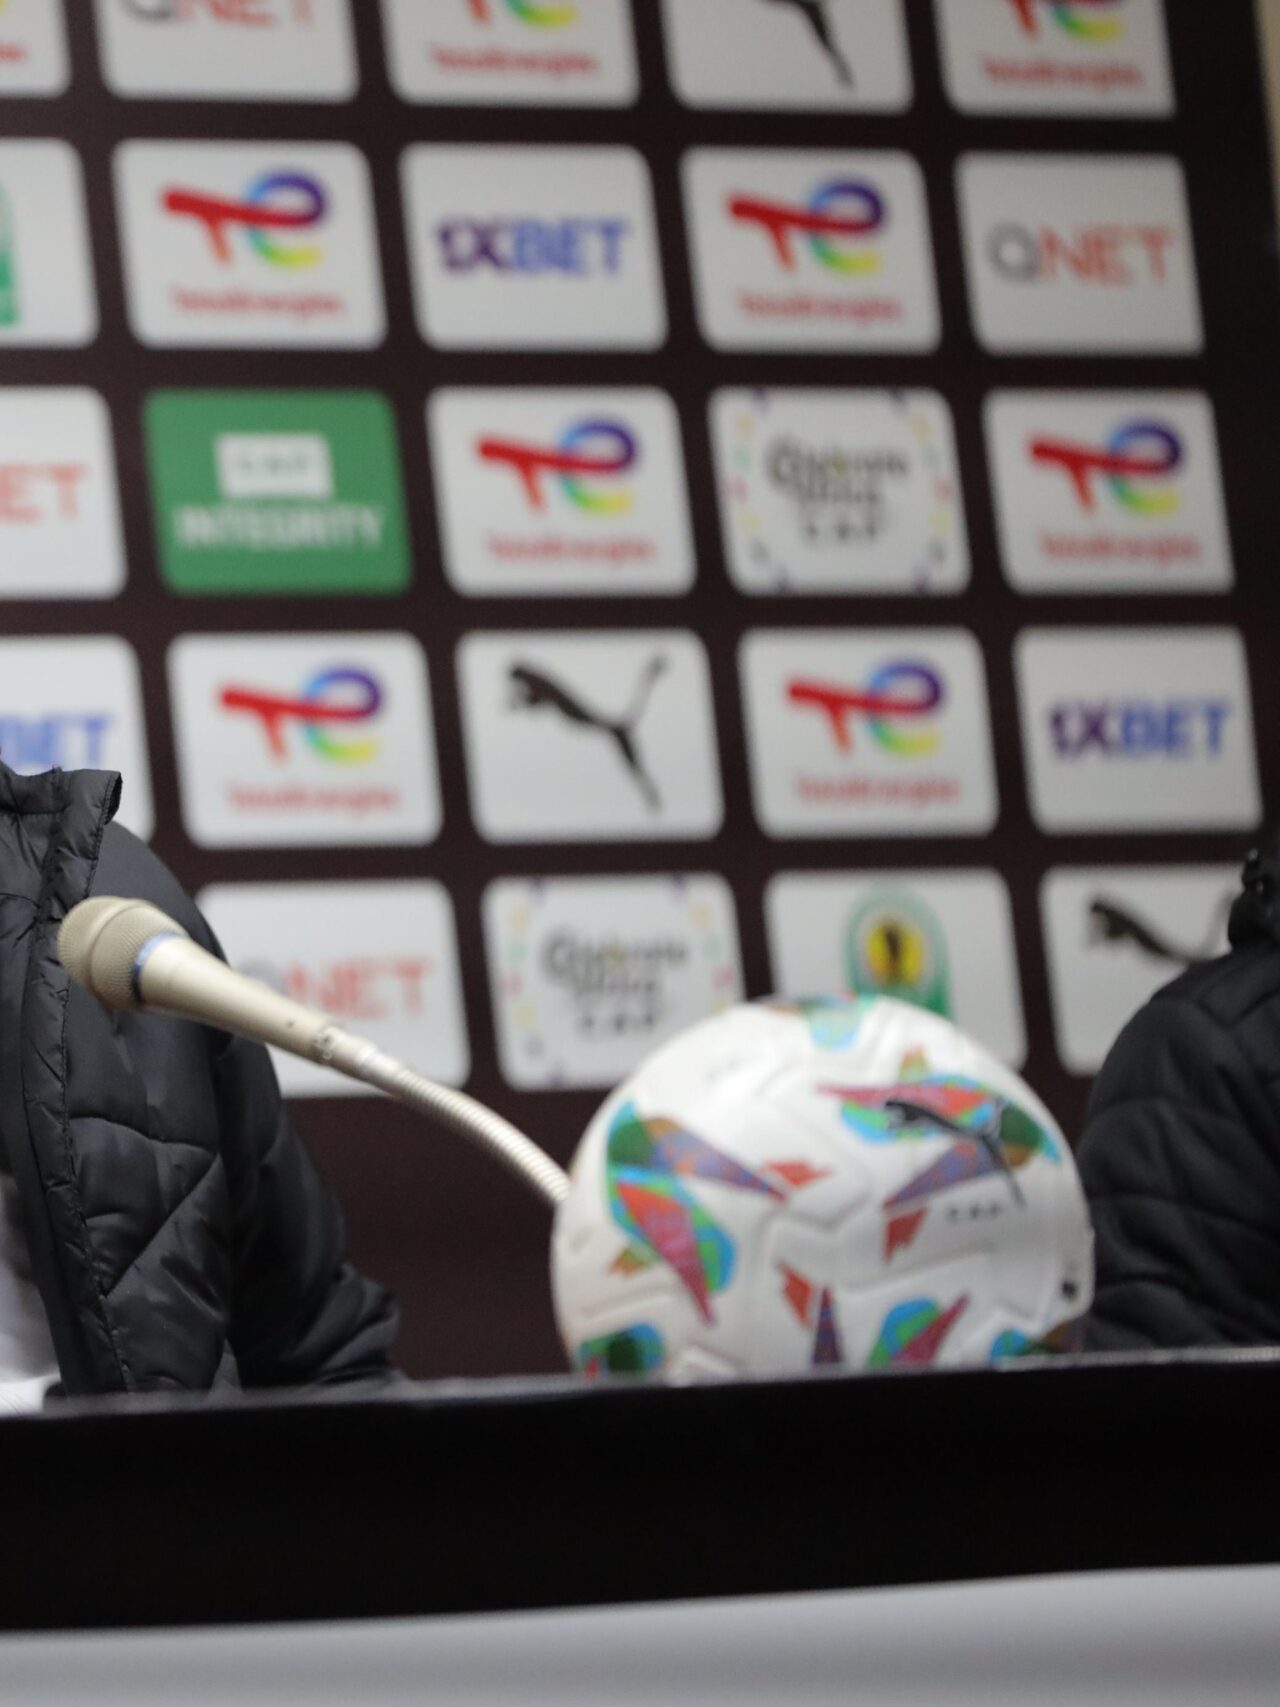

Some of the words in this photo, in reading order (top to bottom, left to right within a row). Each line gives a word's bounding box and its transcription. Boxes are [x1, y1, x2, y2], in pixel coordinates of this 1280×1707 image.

[434, 217, 628, 276] 1XBET
[986, 222, 1173, 286] QNET
[175, 503, 385, 548] INTEGRITY
[1047, 700, 1229, 760] 1XBET
